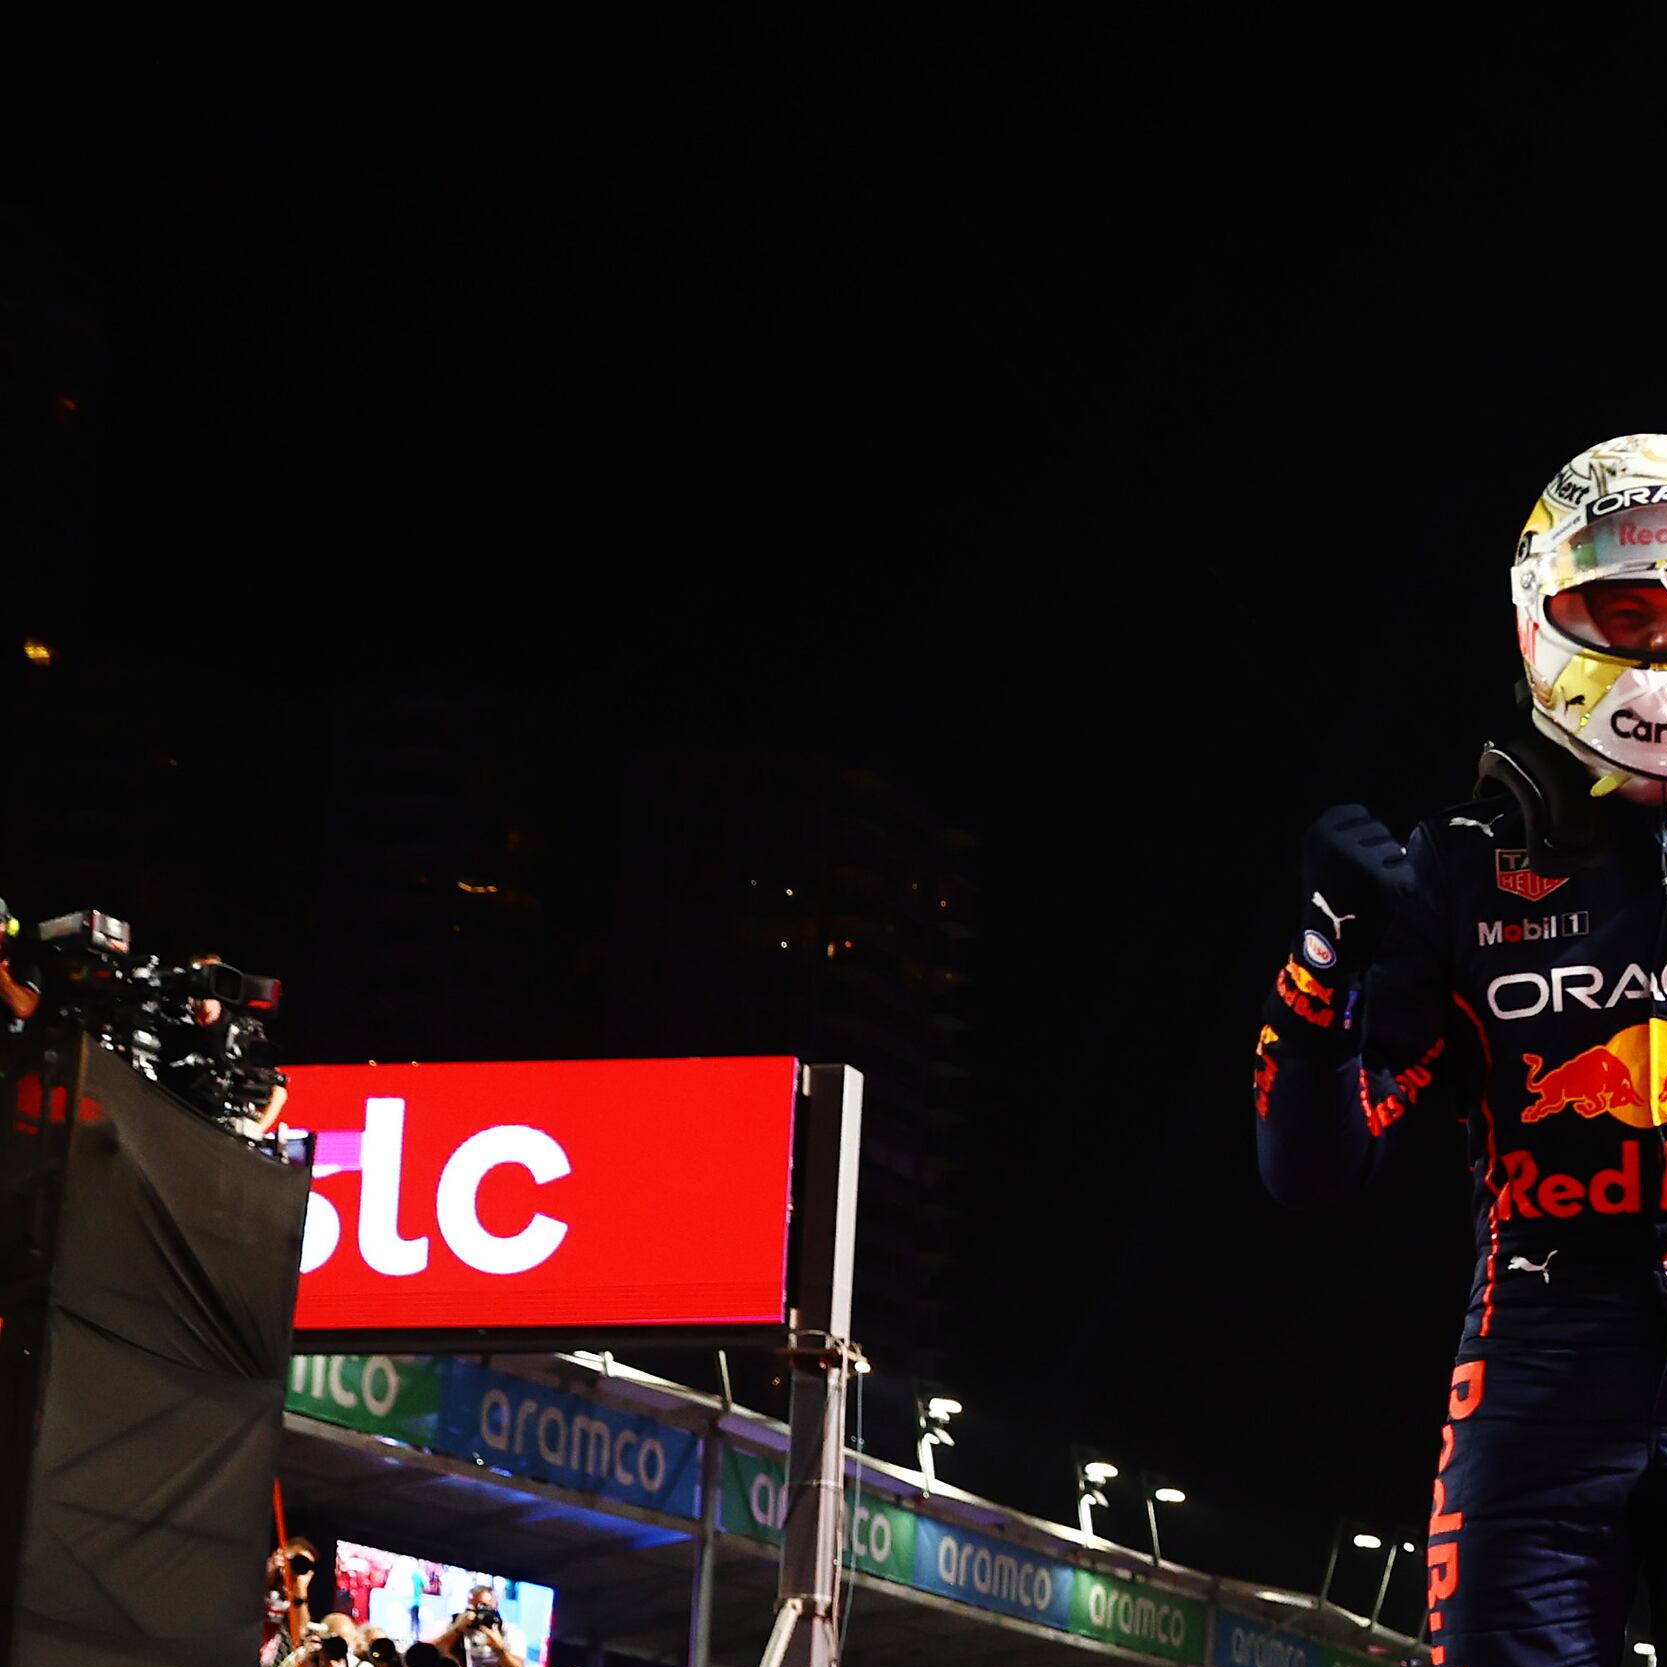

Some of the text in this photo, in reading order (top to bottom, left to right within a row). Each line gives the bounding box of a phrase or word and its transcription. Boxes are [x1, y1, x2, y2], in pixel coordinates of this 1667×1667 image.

[1478, 915, 1557, 947] Mobil
[1491, 1141, 1639, 1219] Red
[480, 1389, 667, 1493] aramco
[938, 1535, 1053, 1612] aramco
[1088, 1582, 1186, 1649] aramco
